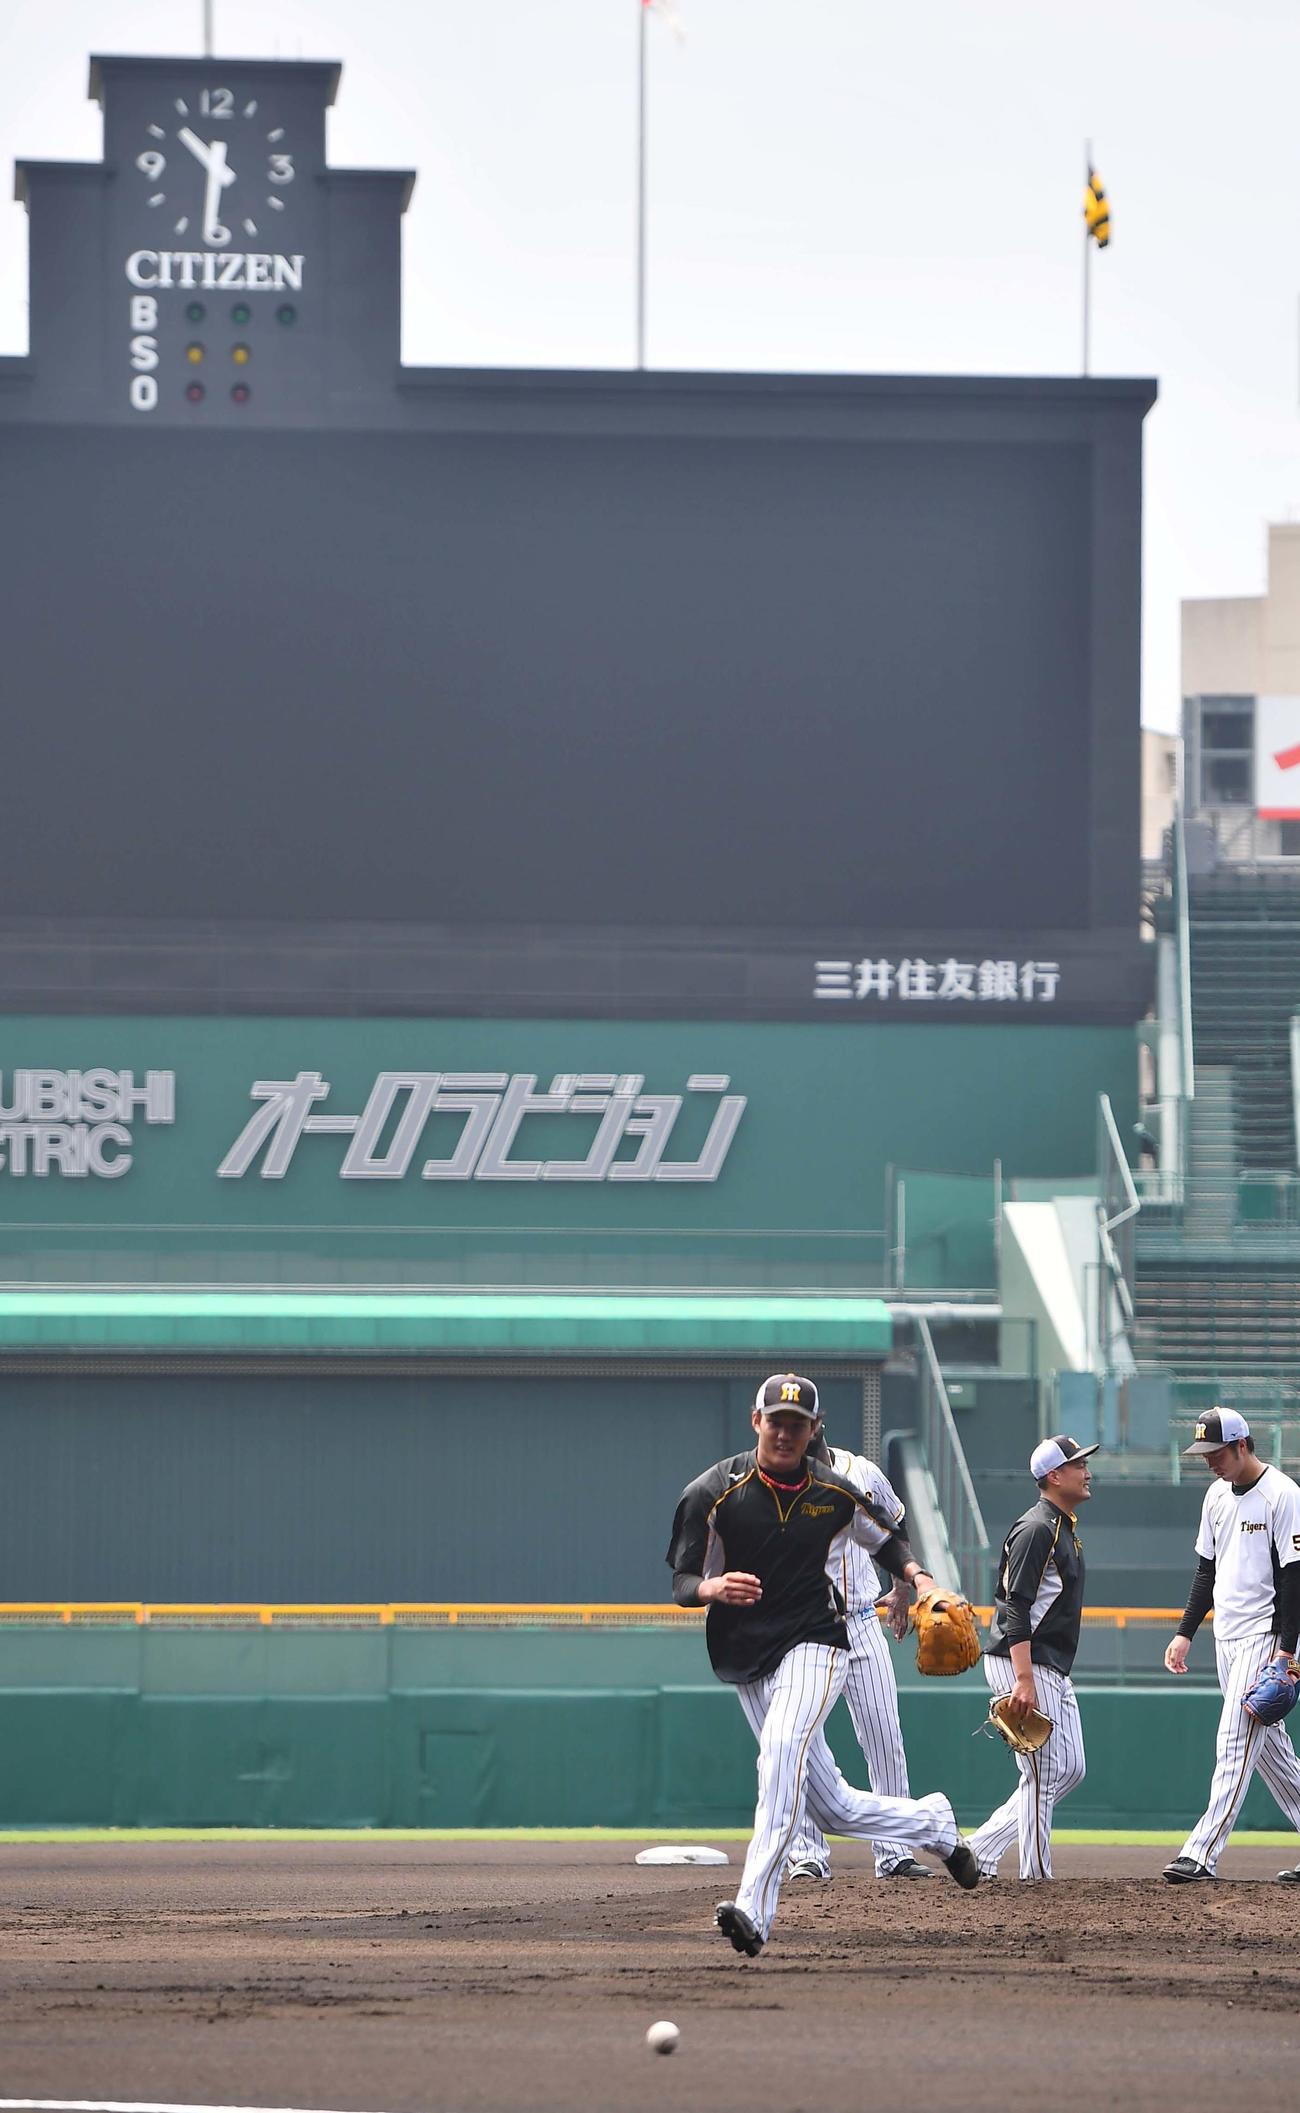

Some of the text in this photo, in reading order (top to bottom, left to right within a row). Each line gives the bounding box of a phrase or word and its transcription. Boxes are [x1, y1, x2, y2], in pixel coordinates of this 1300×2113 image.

[201, 87, 235, 119] 12
[136, 151, 166, 181] 9
[268, 154, 295, 184] 3
[125, 250, 305, 290] CITIZEN
[130, 295, 158, 332] B
[130, 335, 159, 371] S
[130, 375, 158, 411] O
[813, 957, 1061, 1002] 三井住友銀行
[0, 1122, 133, 1179] TRIC
[1240, 1520, 1267, 1535] Tigers
